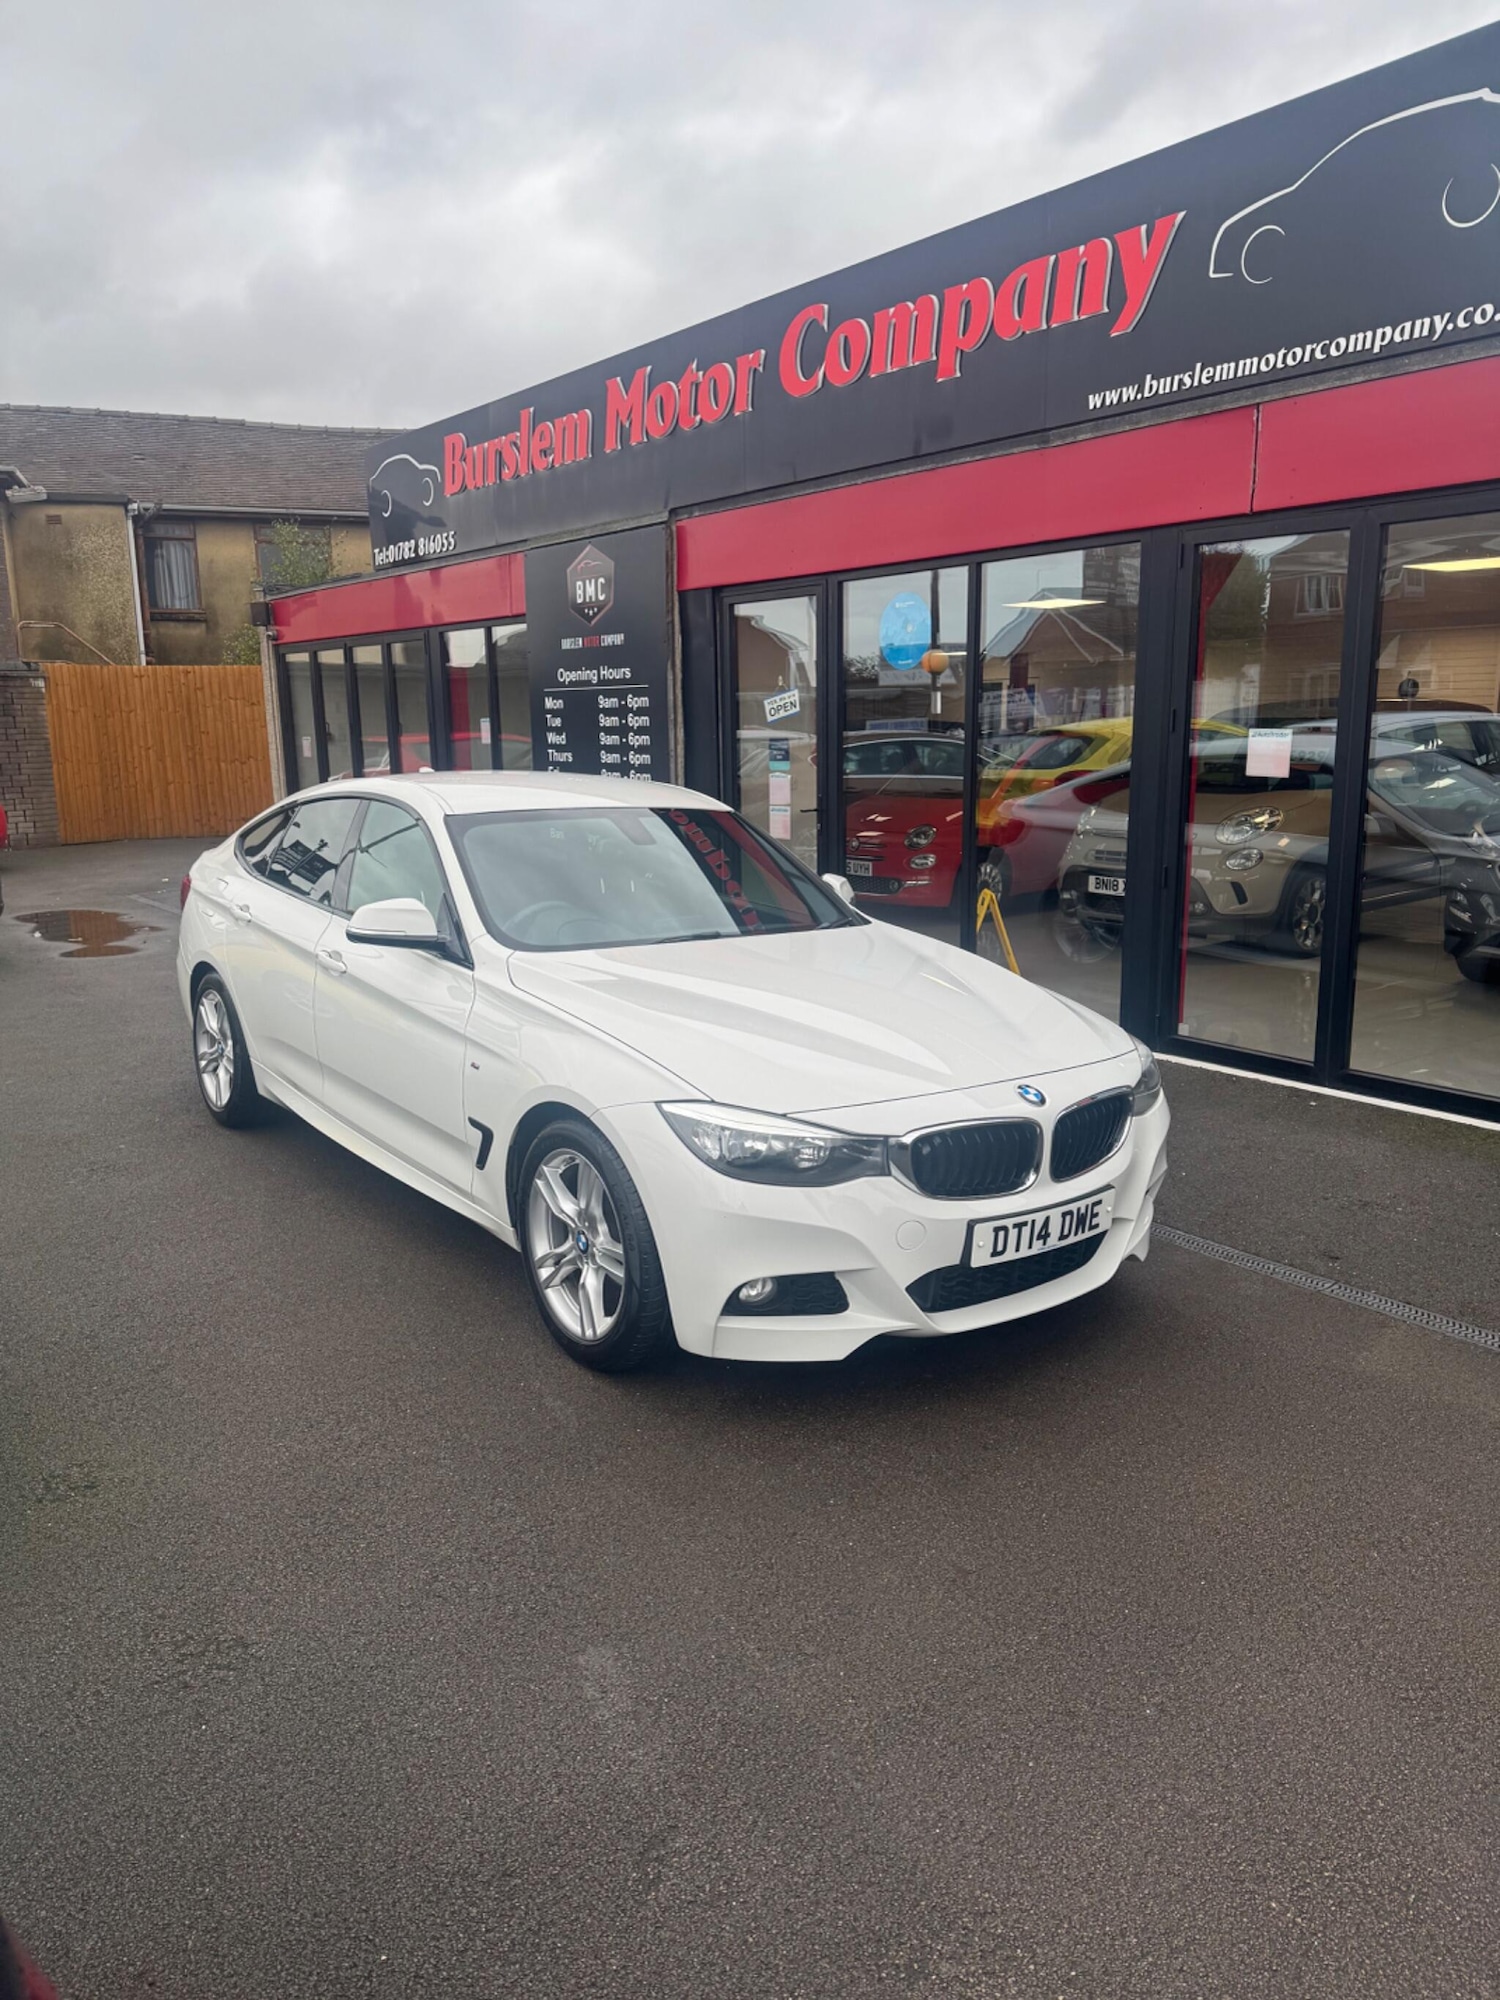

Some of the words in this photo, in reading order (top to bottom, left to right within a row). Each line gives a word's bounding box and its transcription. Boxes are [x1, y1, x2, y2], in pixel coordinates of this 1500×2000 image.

[443, 407, 593, 498] Burslem
[603, 349, 765, 455] Motor
[778, 211, 1186, 398] Company
[373, 539, 416, 566] Tel:01782
[418, 530, 456, 556] 816055
[576, 577, 606, 603] BMC
[557, 667, 598, 685] Opening
[600, 665, 632, 680] Hours
[544, 697, 564, 709] Mon
[598, 695, 619, 708] 9am
[627, 694, 650, 711] 6pm
[769, 699, 797, 717] OPEN
[546, 714, 562, 727] Tue
[599, 713, 620, 727] 9am
[627, 712, 650, 730] 6pm
[547, 732, 567, 745] Wed
[600, 732, 621, 745] 9am
[628, 732, 651, 749] 6pm
[547, 750, 573, 762] Thurs
[600, 750, 621, 763] 9am
[629, 751, 652, 767] 6pm
[1094, 877, 1119, 892] BN18
[990, 1215, 1051, 1257] DT14
[1058, 1199, 1102, 1241] DWE
